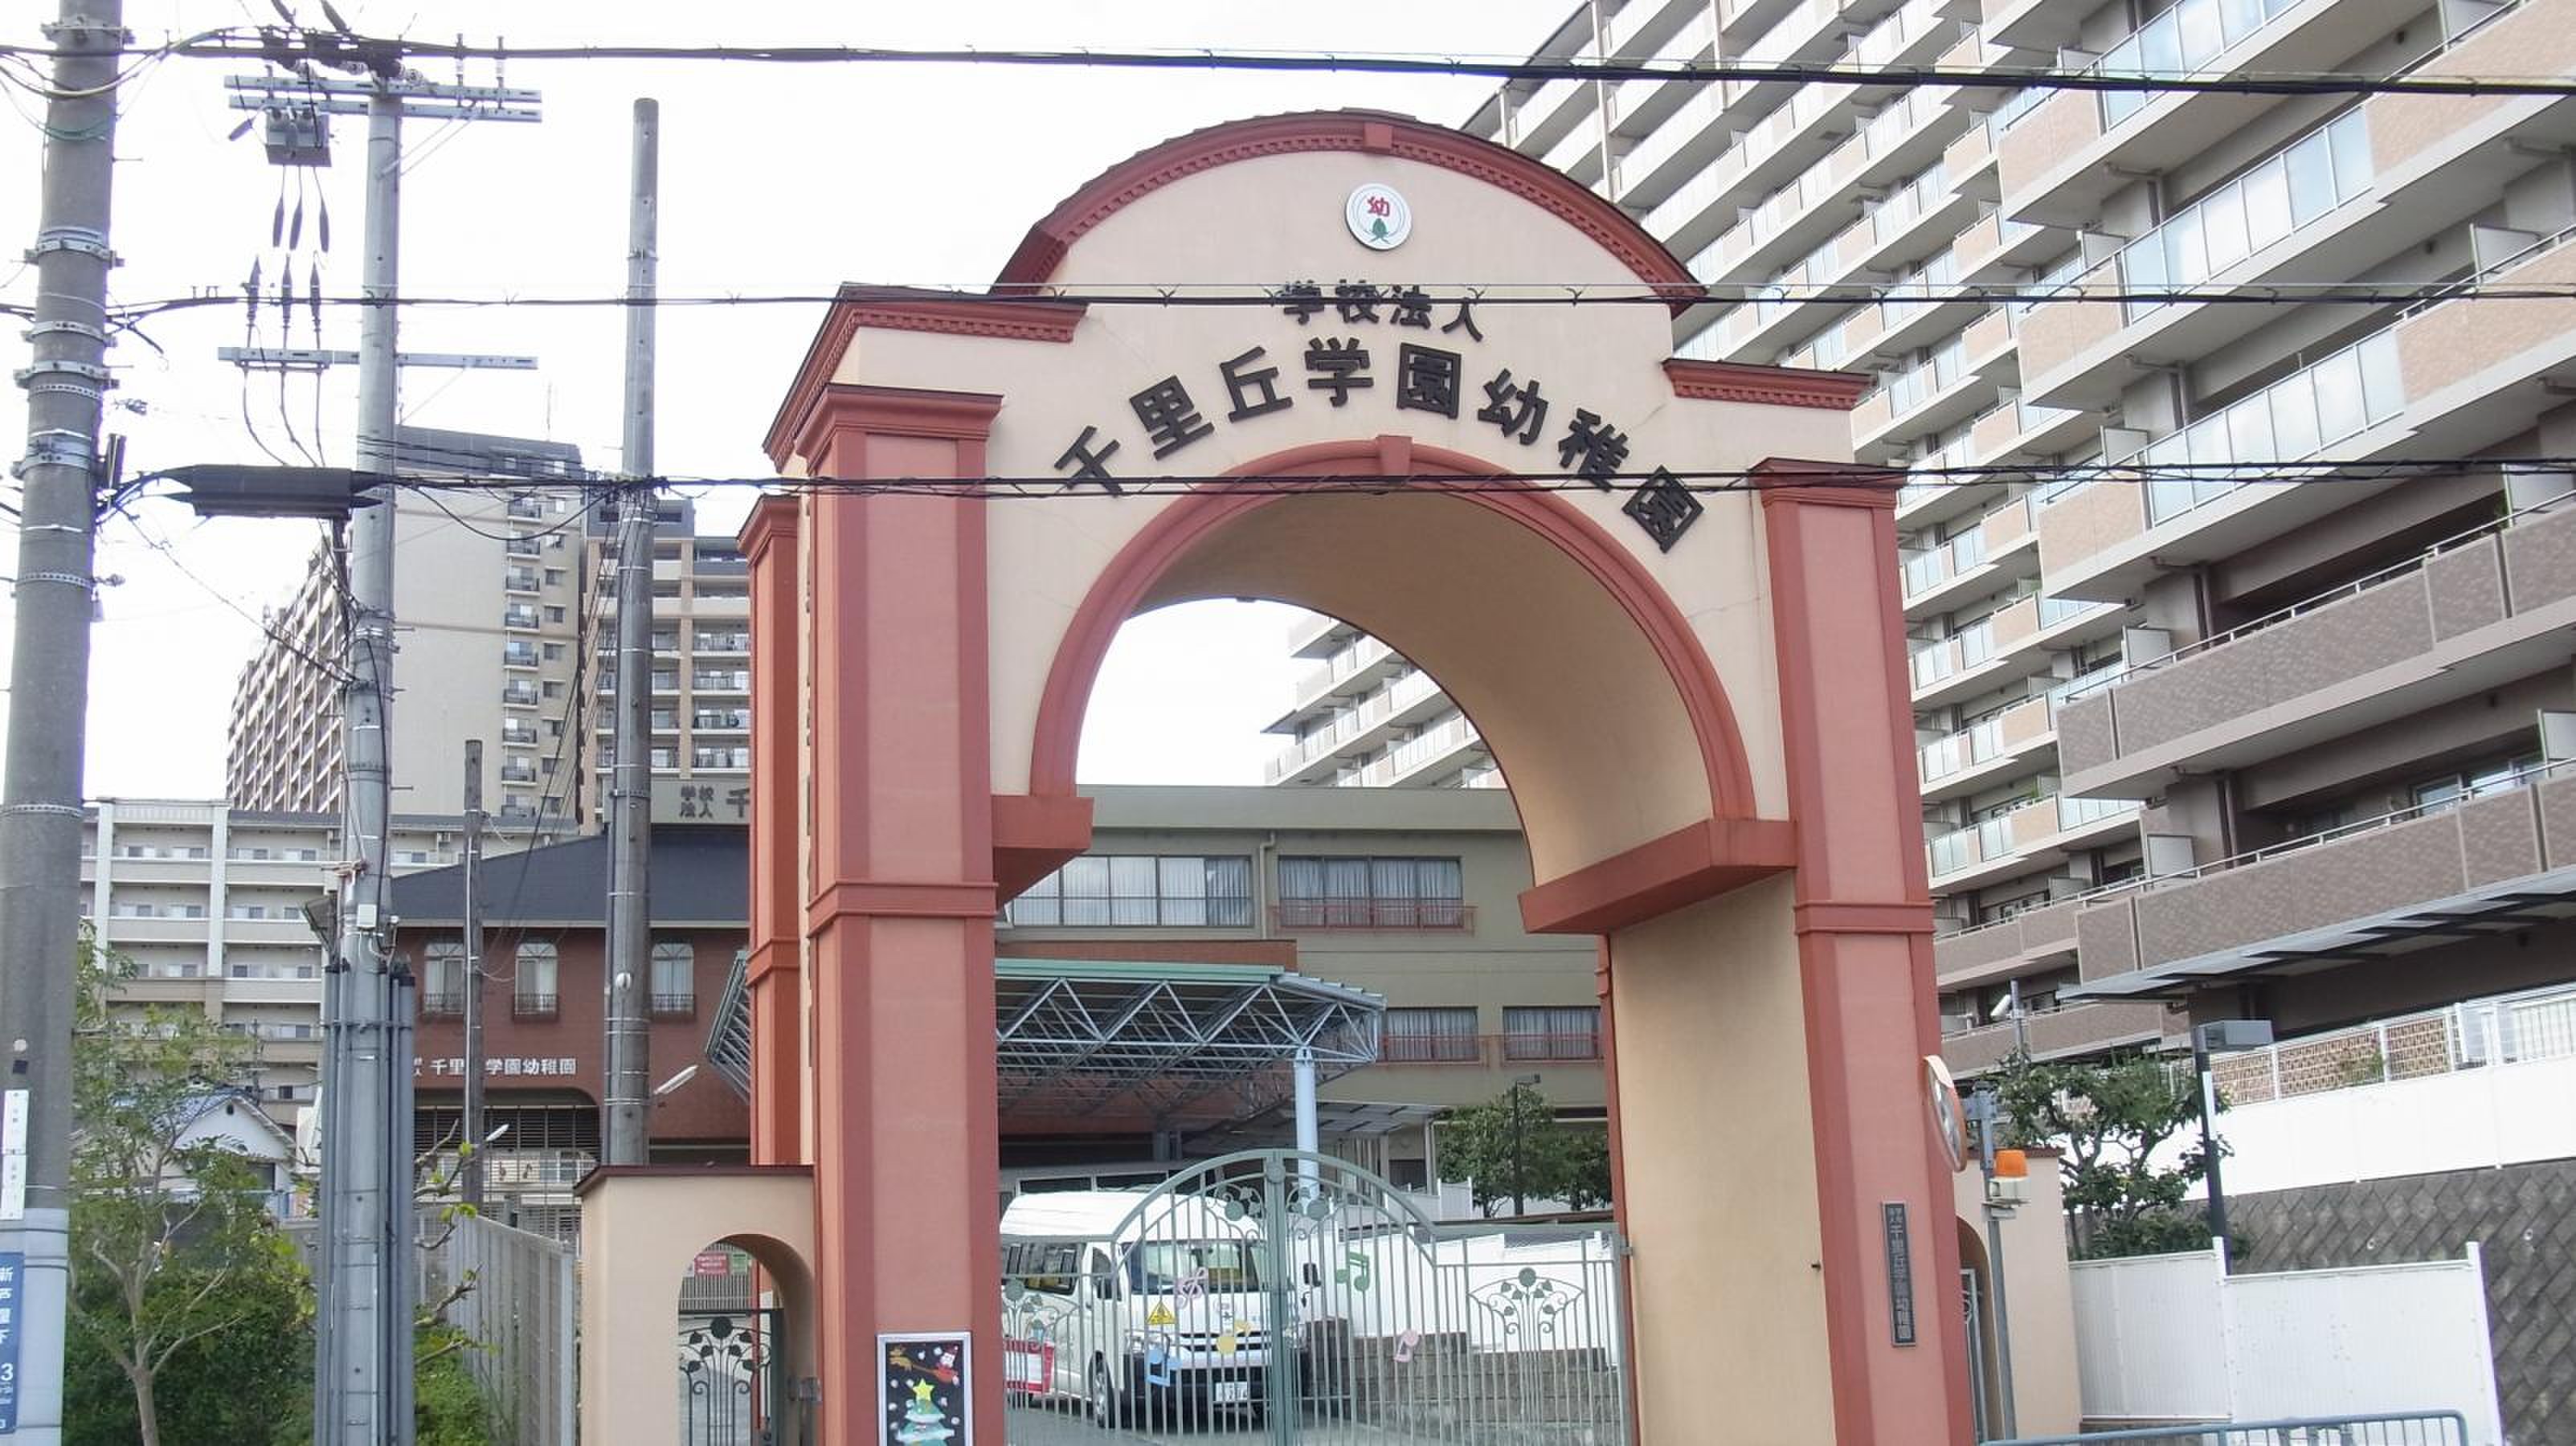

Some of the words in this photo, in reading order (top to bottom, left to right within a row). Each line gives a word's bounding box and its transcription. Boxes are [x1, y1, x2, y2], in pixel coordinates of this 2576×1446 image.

[1367, 195, 1391, 218] 幼
[1283, 279, 1483, 342] 学校法人
[1053, 336, 1705, 554] 千里丘学園幼稚園
[429, 1057, 577, 1076] 千里学園幼稚園
